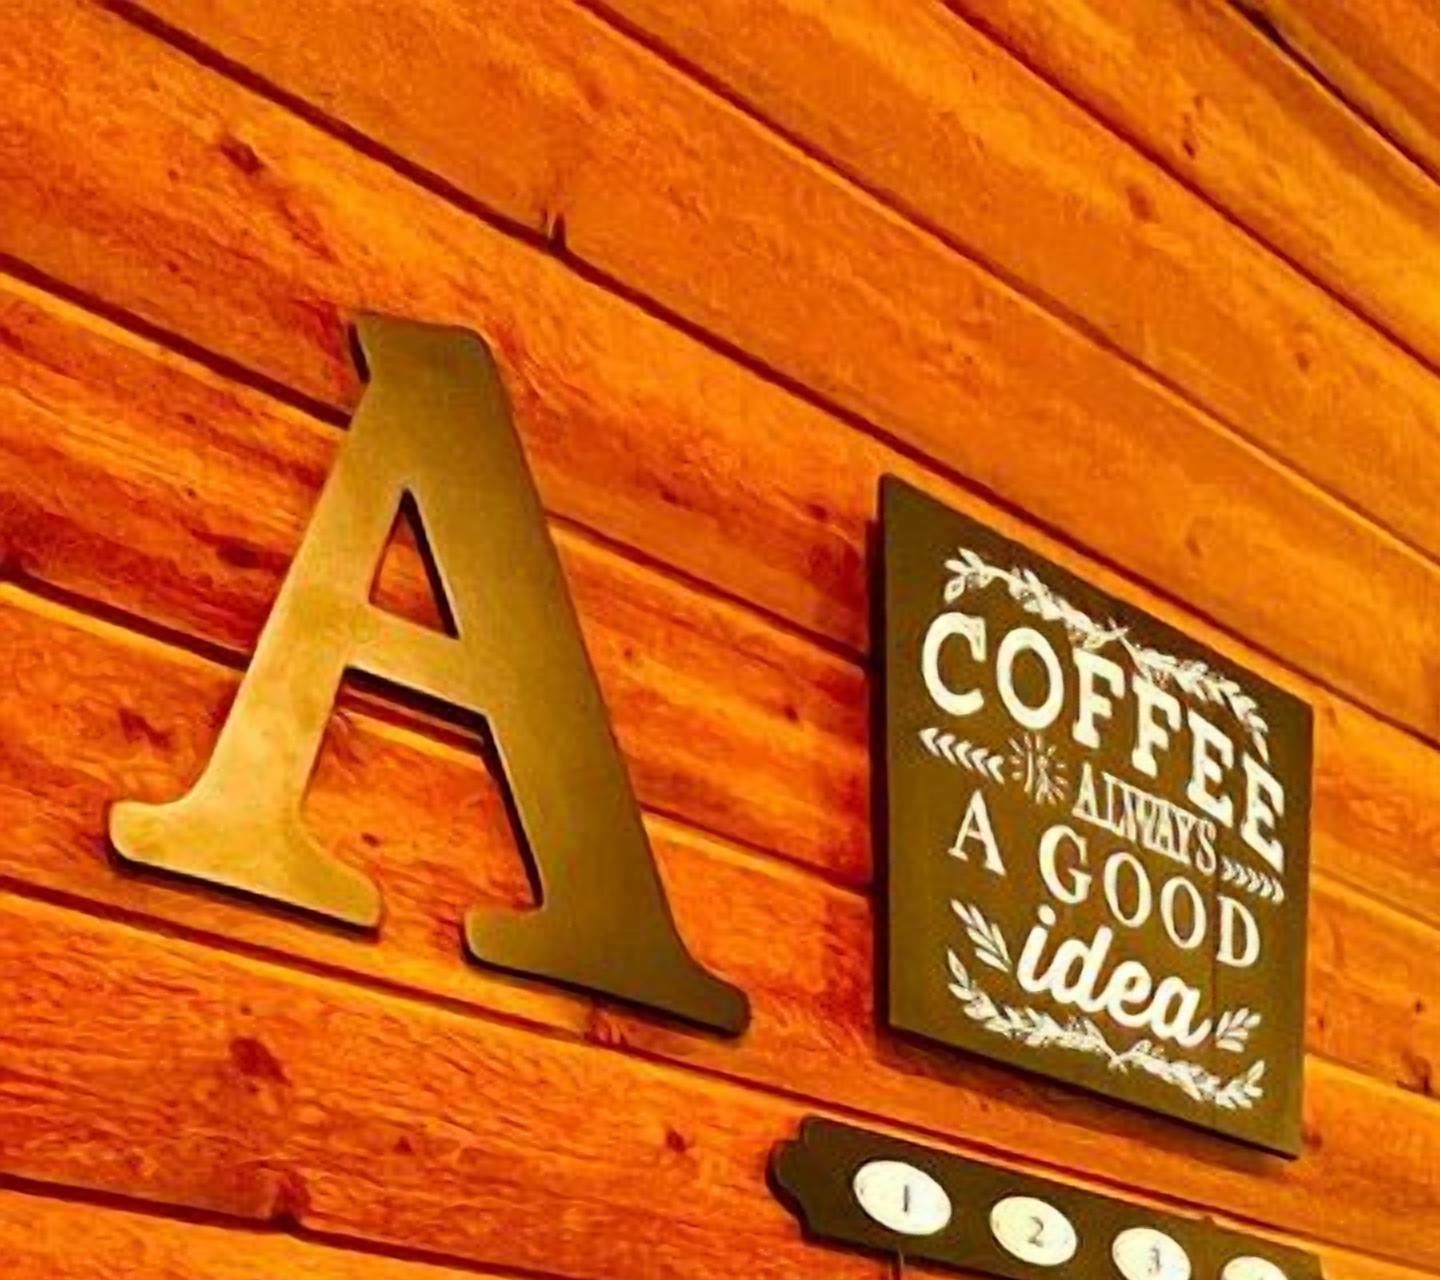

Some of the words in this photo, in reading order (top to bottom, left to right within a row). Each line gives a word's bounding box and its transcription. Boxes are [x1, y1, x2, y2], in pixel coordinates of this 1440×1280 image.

[108, 311, 752, 1037] A
[921, 610, 1286, 872] COFFEE
[948, 789, 1006, 877] A
[1038, 824, 1262, 969] GOOD
[1072, 762, 1217, 877] ALWAYS
[1016, 904, 1216, 1049] idea
[902, 1185, 911, 1213] 1
[1027, 1215, 1045, 1248] 2
[1147, 1246, 1162, 1274] 3
